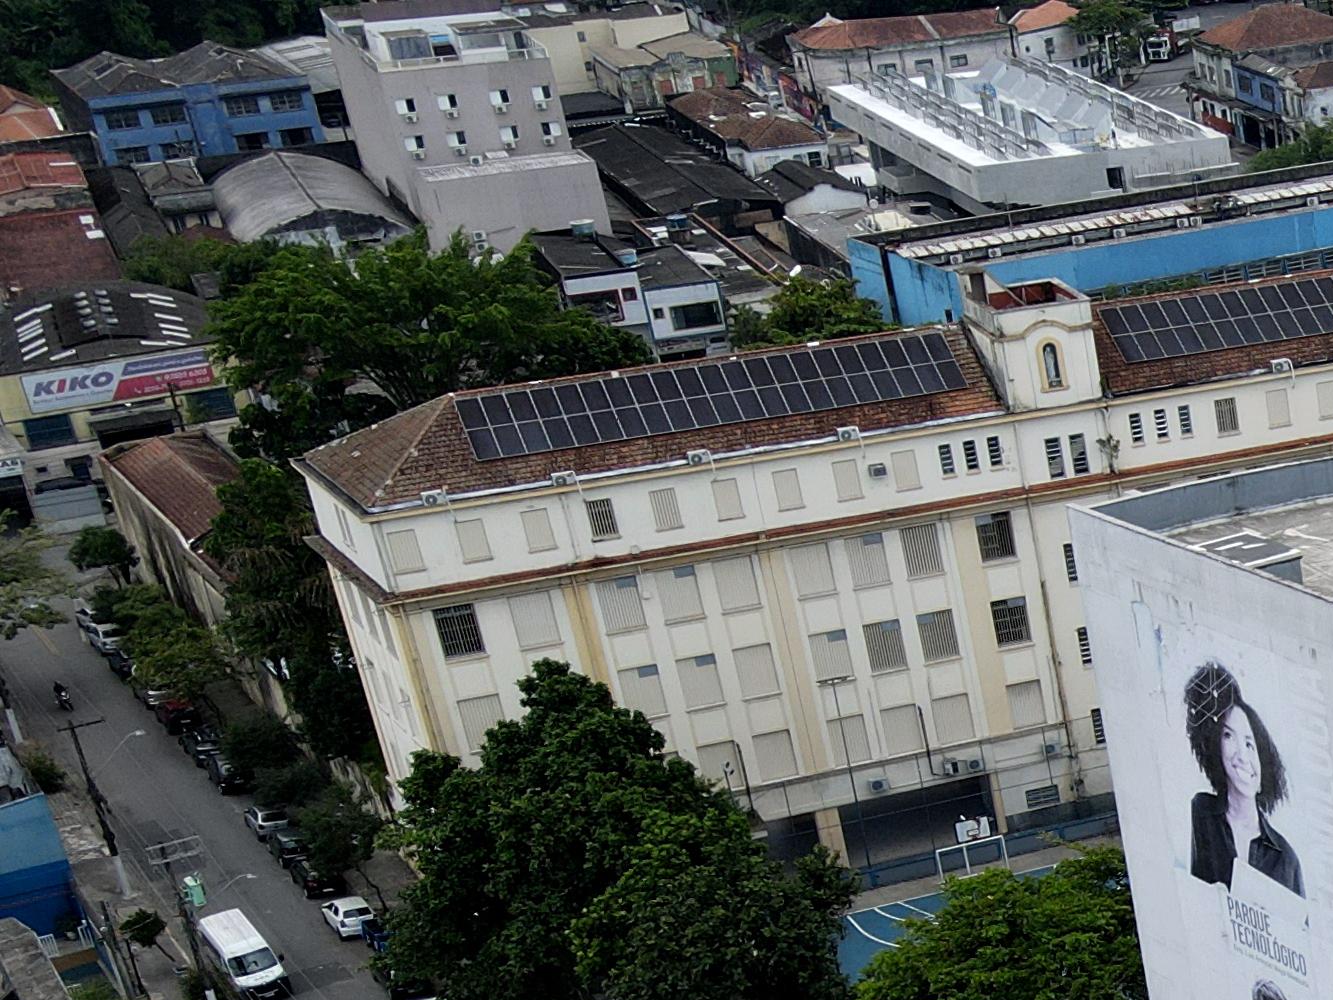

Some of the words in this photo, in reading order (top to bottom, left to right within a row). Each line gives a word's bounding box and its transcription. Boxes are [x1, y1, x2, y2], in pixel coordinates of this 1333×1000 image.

[33, 371, 114, 397] KIKO
[1227, 895, 1273, 936] PARQUE
[1230, 918, 1307, 977] TECNOLÓGICO
